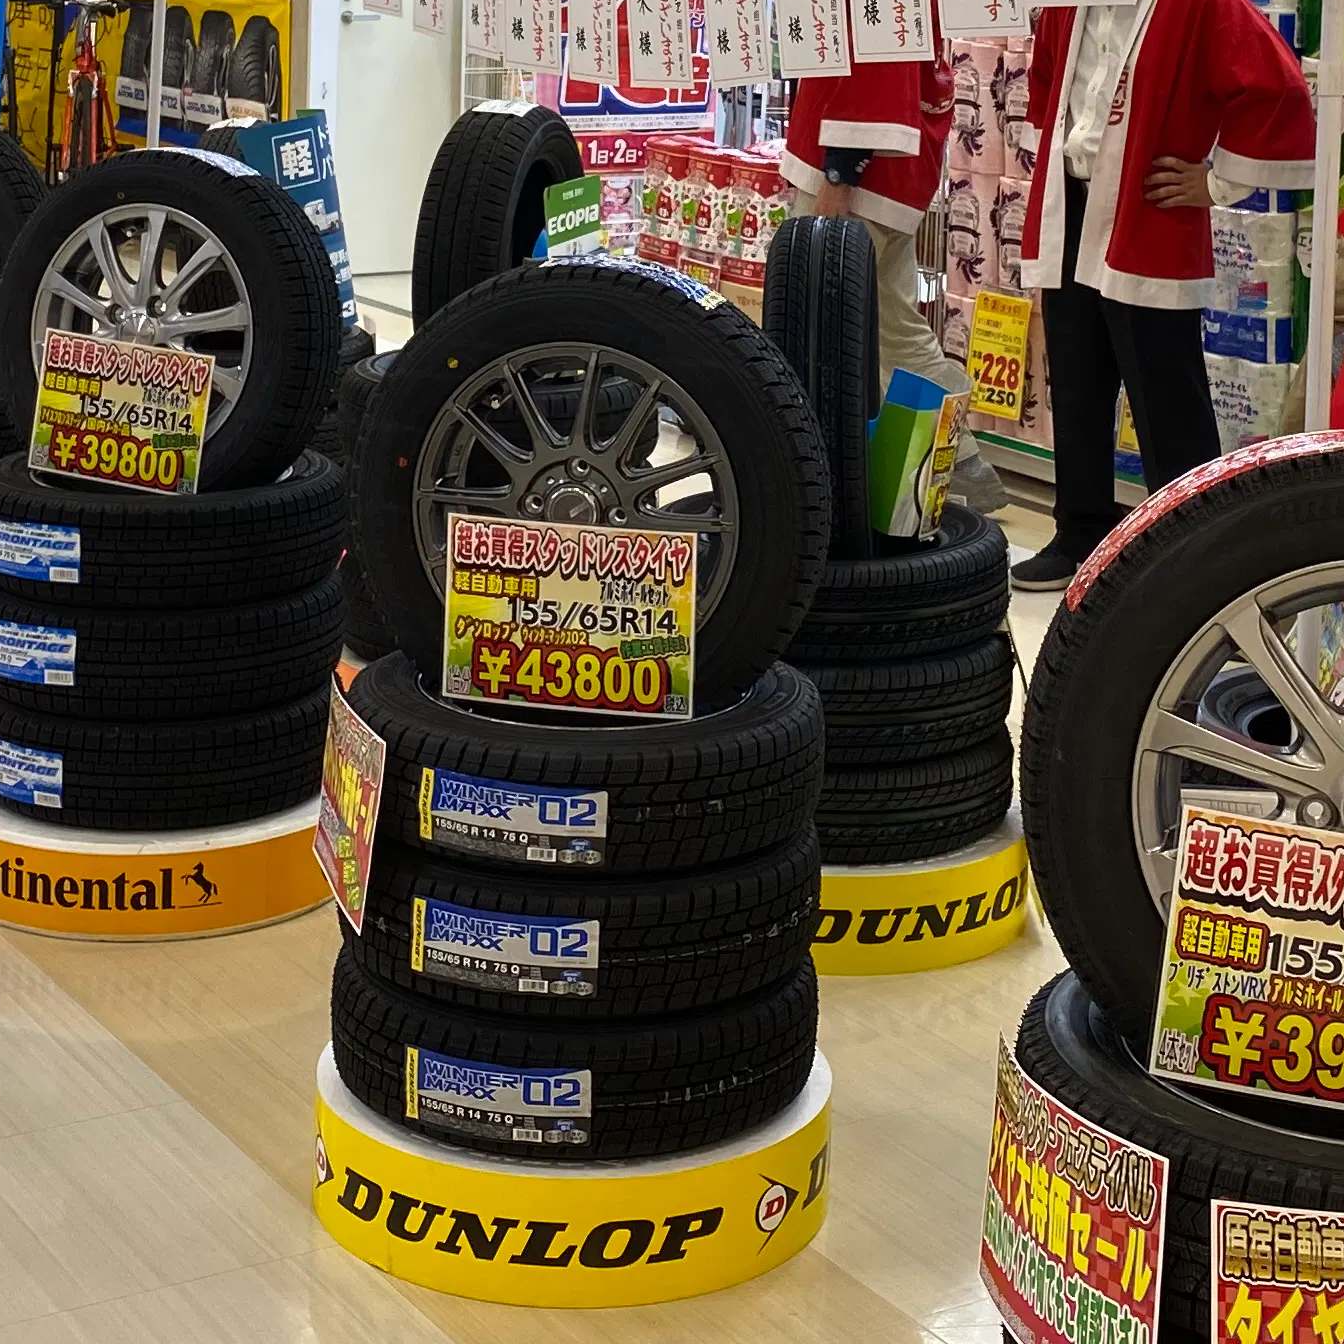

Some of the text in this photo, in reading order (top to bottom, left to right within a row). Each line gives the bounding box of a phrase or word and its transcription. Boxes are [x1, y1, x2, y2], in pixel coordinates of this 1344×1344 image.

[78, 396, 193, 433] 155/65R14
[53, 431, 179, 486] ¥39800
[454, 520, 692, 582] 超お買得スタッドレスタイヤ
[453, 570, 538, 599] 軽自動車用
[507, 600, 677, 638] 155/65R14
[477, 646, 662, 706] ¥43800
[438, 793, 513, 822] MAXX
[440, 777, 537, 809] WINTER
[537, 794, 598, 828] 02
[482, 828, 496, 839] 14
[430, 923, 504, 952] MAXX
[431, 907, 528, 940] WINTER
[1179, 912, 1266, 967] 軽自動車用
[528, 924, 589, 958] 02
[474, 959, 488, 971] 14
[423, 1073, 497, 1102] MAXX
[424, 1057, 521, 1090] WINTER
[521, 1074, 582, 1108] 02
[467, 1108, 481, 1120] 14
[337, 1166, 724, 1269] DUNLOP
